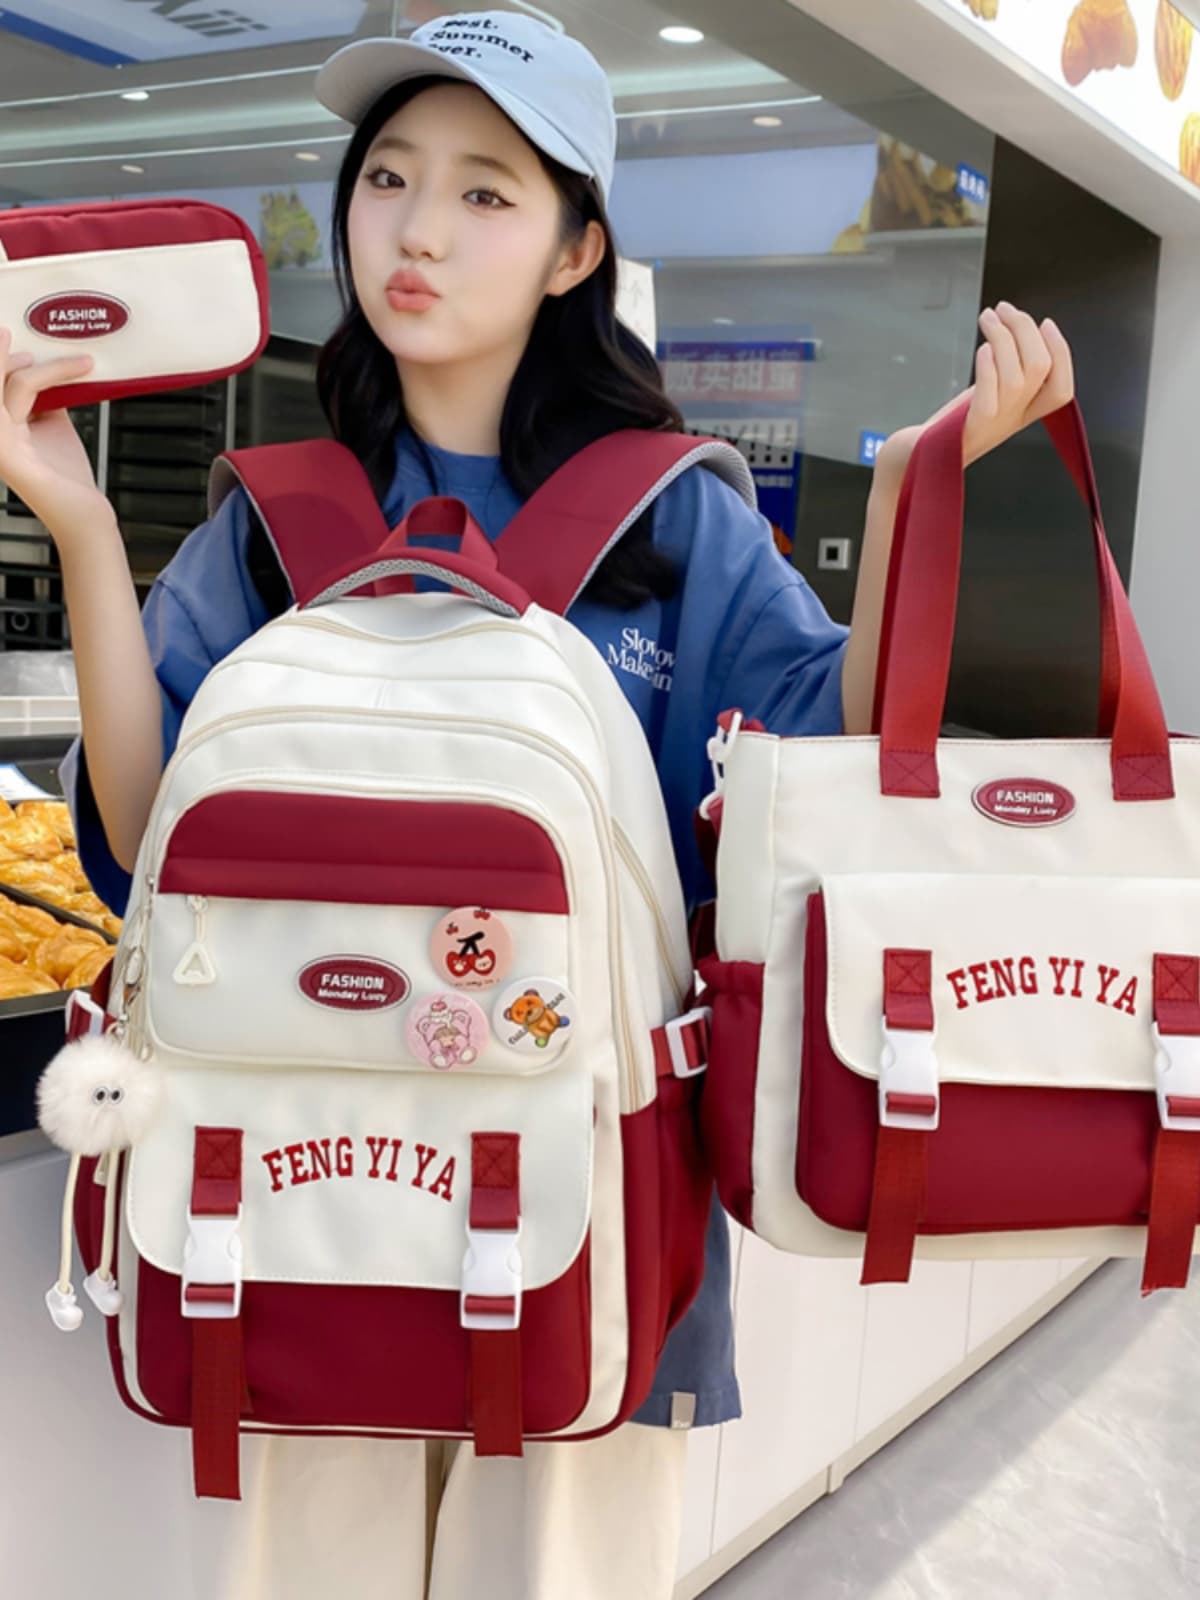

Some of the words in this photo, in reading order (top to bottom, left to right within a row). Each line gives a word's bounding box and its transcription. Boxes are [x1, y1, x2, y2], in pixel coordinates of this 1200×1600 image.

[48, 308, 107, 321] FASHION
[996, 789, 1055, 804] FASHION
[321, 973, 384, 990] FASHION
[946, 956, 1039, 1010] FENG
[1048, 956, 1085, 998] YI
[1096, 964, 1138, 1016] YA
[261, 1136, 353, 1193] FENG
[365, 1136, 403, 1182] YI
[411, 1143, 457, 1203] YA
